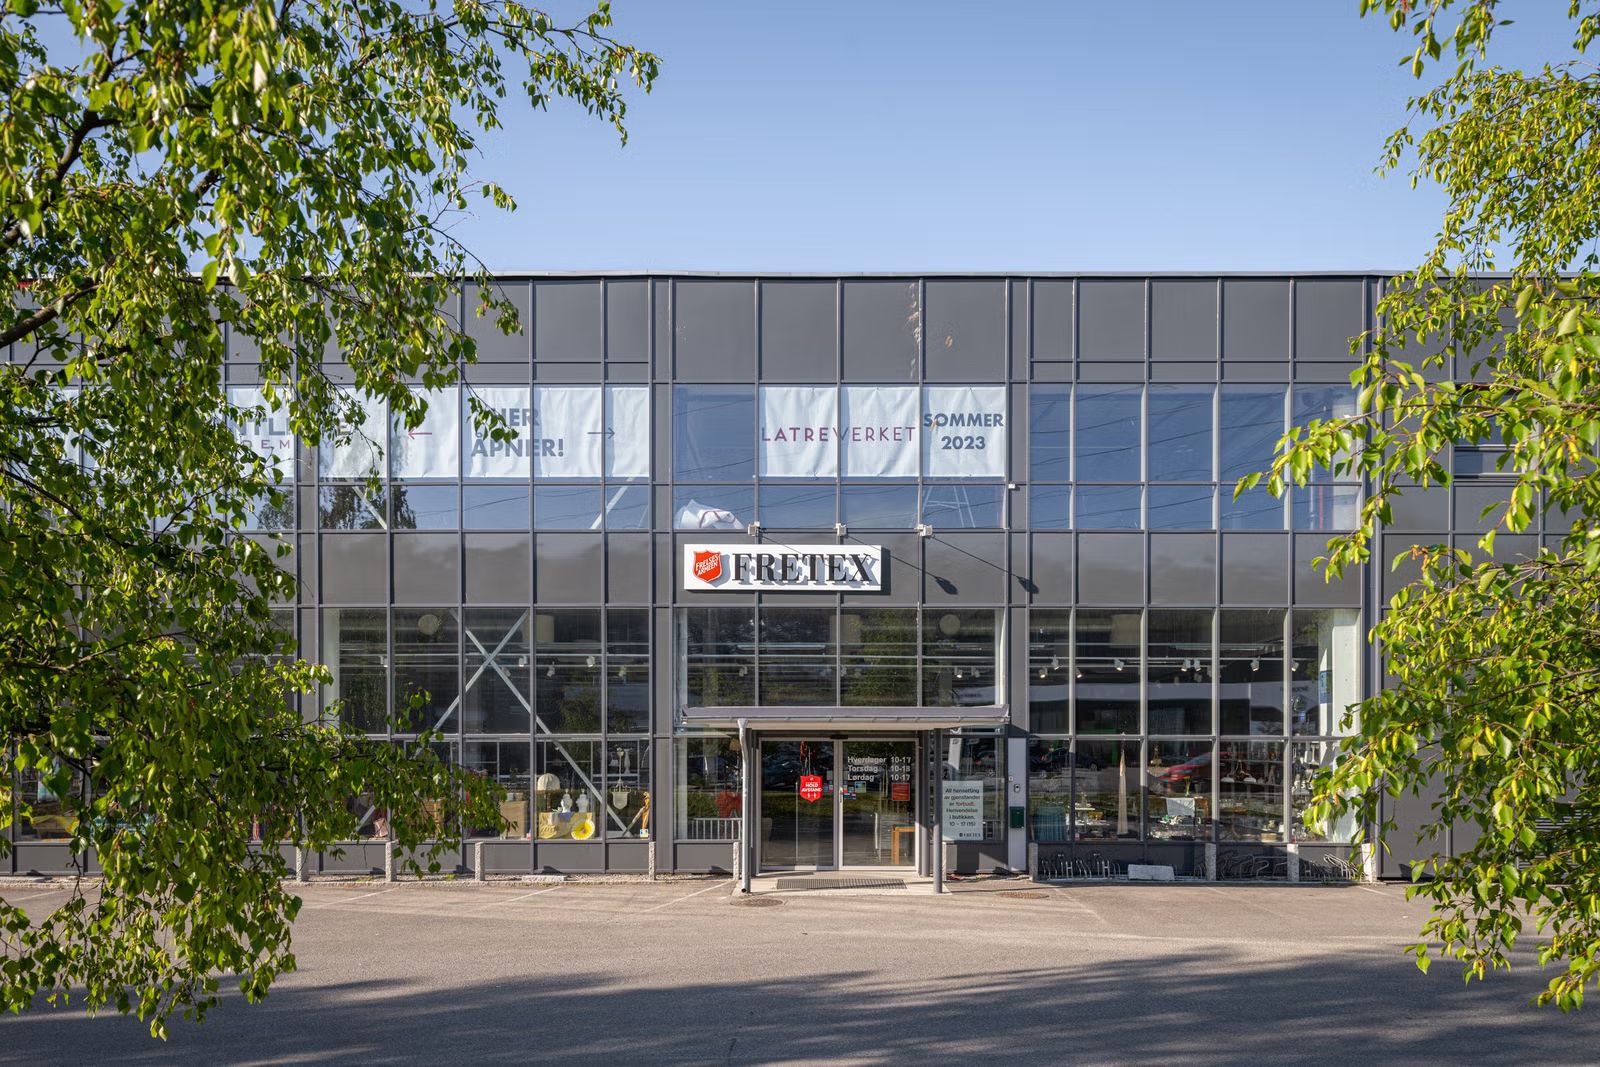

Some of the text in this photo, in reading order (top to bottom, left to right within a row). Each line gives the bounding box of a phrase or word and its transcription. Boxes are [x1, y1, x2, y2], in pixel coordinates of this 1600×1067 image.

[500, 407, 540, 427] ER
[923, 413, 1004, 428] SOMMER
[761, 426, 916, 442] LATREVERKET
[471, 432, 564, 458] ÅPNER!
[941, 435, 986, 450] 2023
[732, 553, 871, 582] FRETEX
[847, 756, 887, 764] Hverdager
[848, 765, 878, 773] Torsdag
[848, 774, 875, 782] Lørdag
